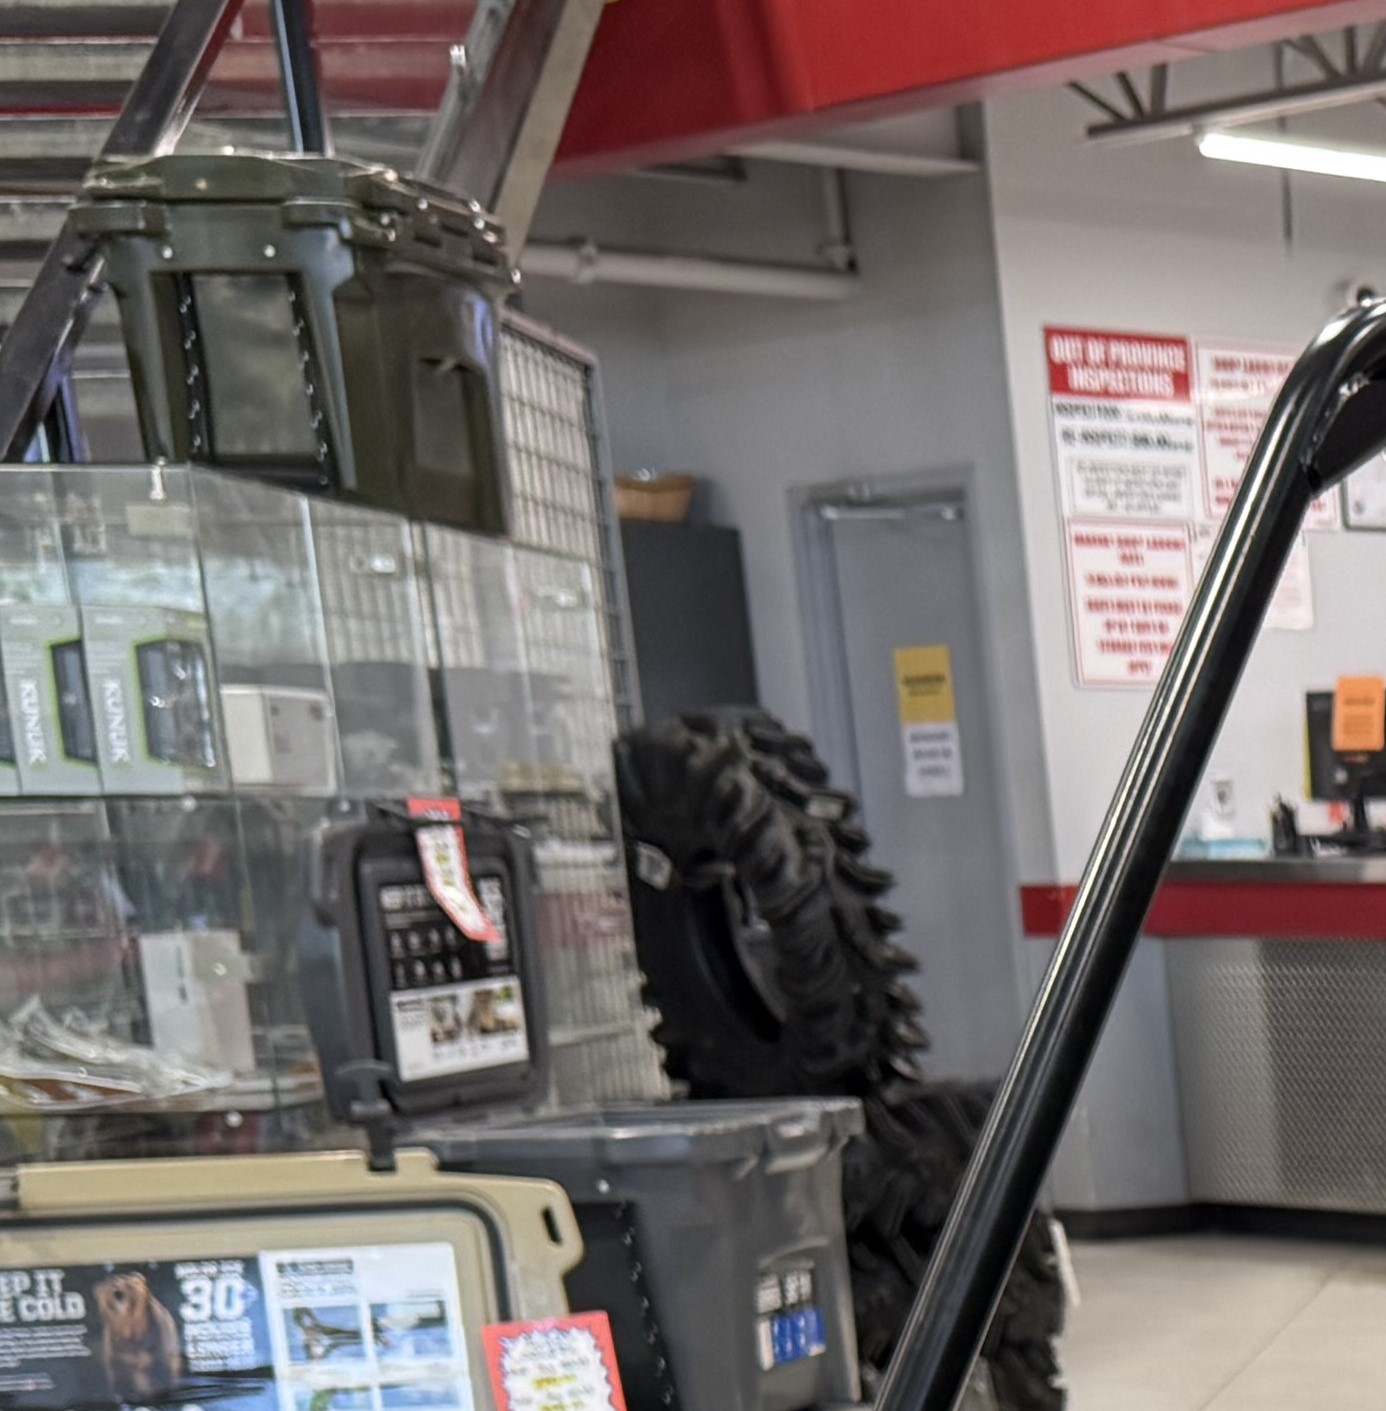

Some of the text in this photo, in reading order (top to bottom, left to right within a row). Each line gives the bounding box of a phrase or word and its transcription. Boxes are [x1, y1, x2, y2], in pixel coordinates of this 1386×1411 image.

[33, 1269, 65, 1297] IT
[179, 1274, 246, 1322] 30
[18, 1291, 87, 1322] COLD
